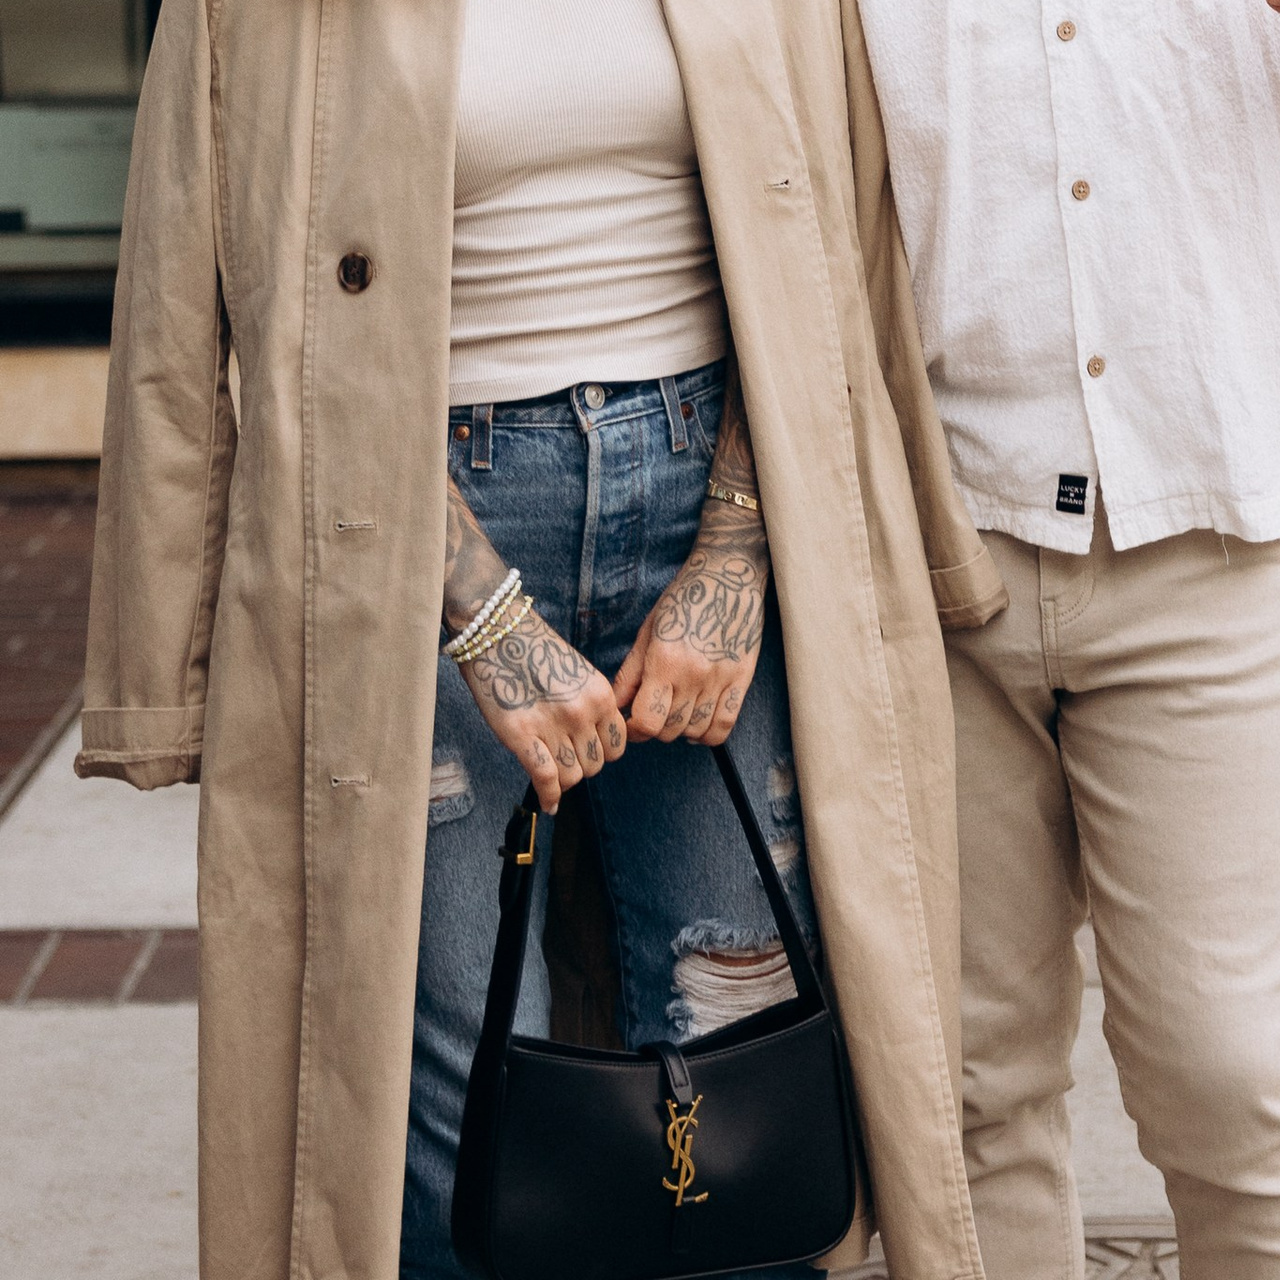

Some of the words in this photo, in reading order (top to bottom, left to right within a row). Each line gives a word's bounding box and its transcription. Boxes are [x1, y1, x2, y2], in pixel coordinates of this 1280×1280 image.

[1060, 484, 1084, 494] LUCKY
[1059, 496, 1083, 505] BRAND
[662, 1094, 709, 1207] YSL
